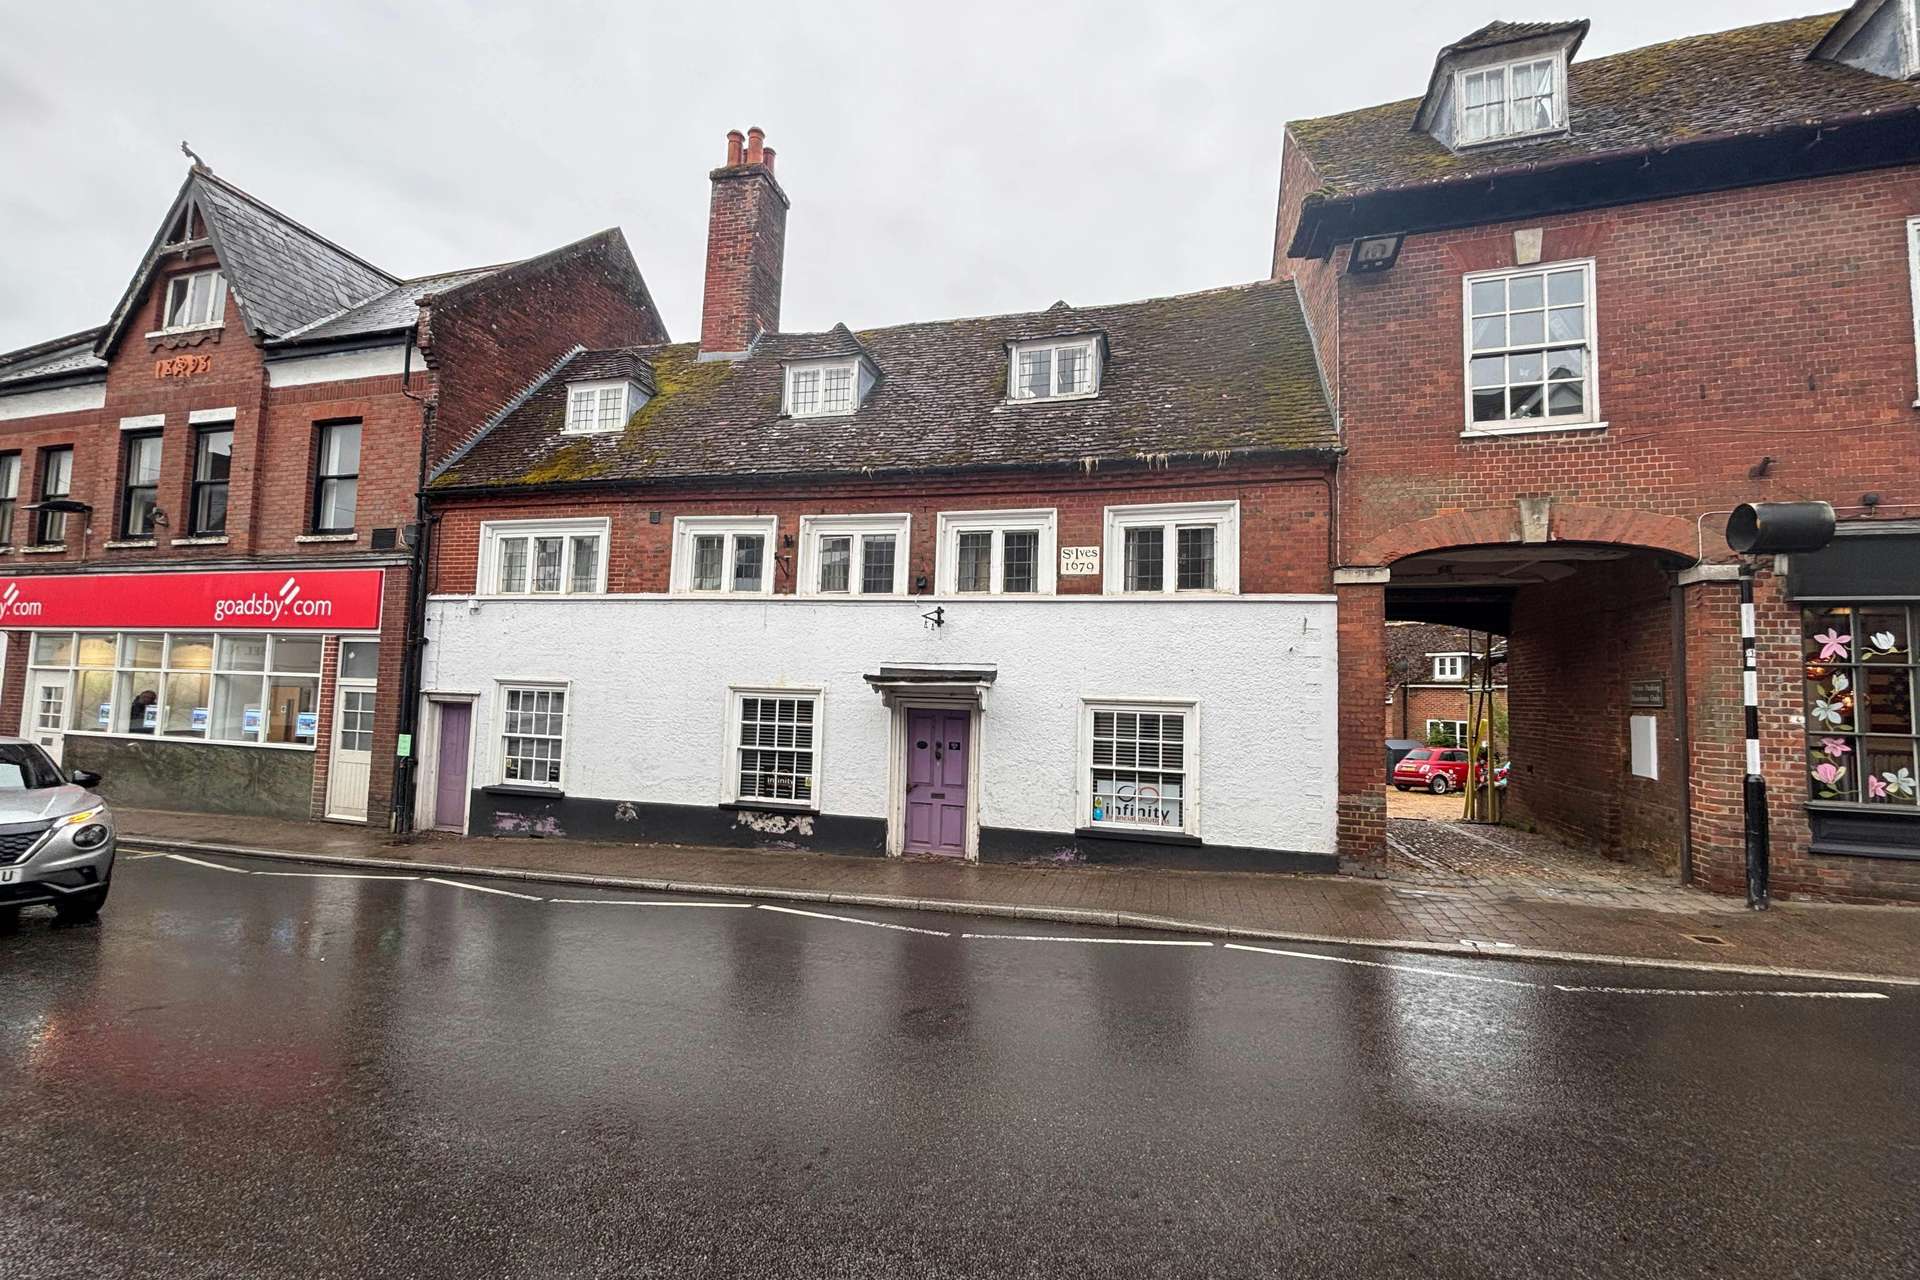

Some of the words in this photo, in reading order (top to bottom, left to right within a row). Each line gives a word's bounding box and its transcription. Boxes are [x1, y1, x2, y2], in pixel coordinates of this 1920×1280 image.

[1075, 548, 1098, 560] Ives
[1065, 559, 1094, 573] 1679
[214, 591, 332, 622] goadsby.com
[1105, 802, 1170, 821] infinity
